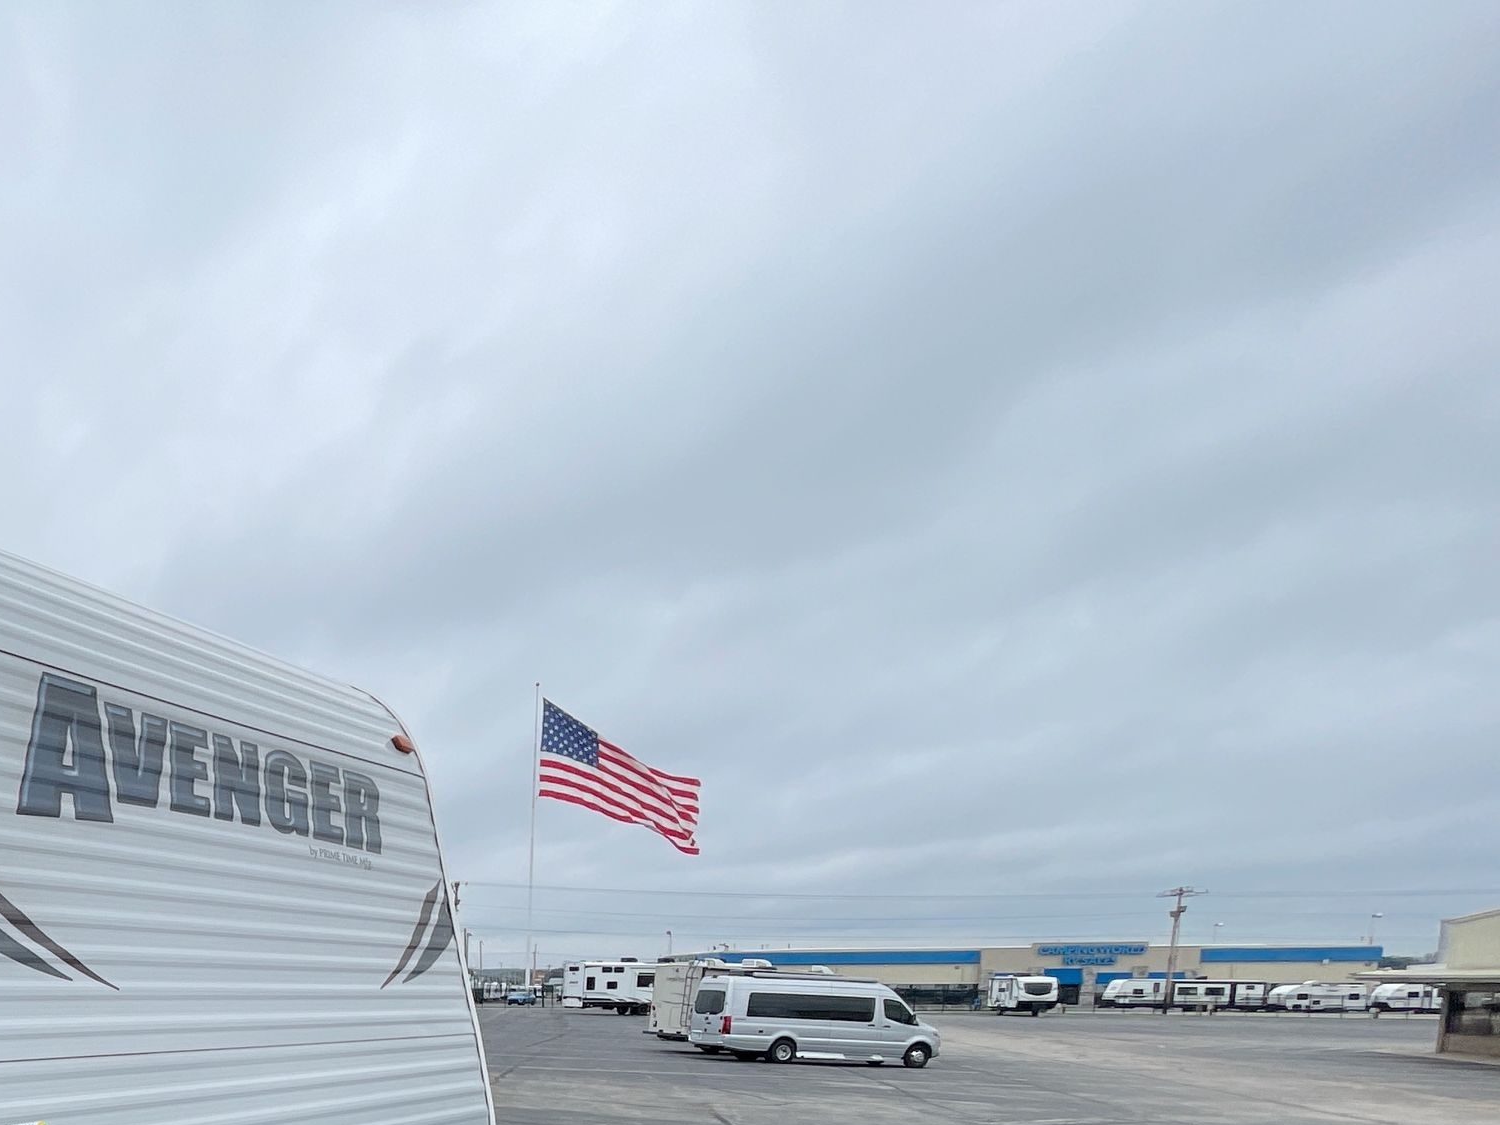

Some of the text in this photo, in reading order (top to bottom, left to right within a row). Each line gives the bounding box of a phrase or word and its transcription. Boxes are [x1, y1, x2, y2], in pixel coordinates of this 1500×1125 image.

[16, 671, 382, 855] AVENGER
[308, 845, 318, 859] by
[319, 848, 340, 861] PRIME
[341, 852, 358, 865] TIME
